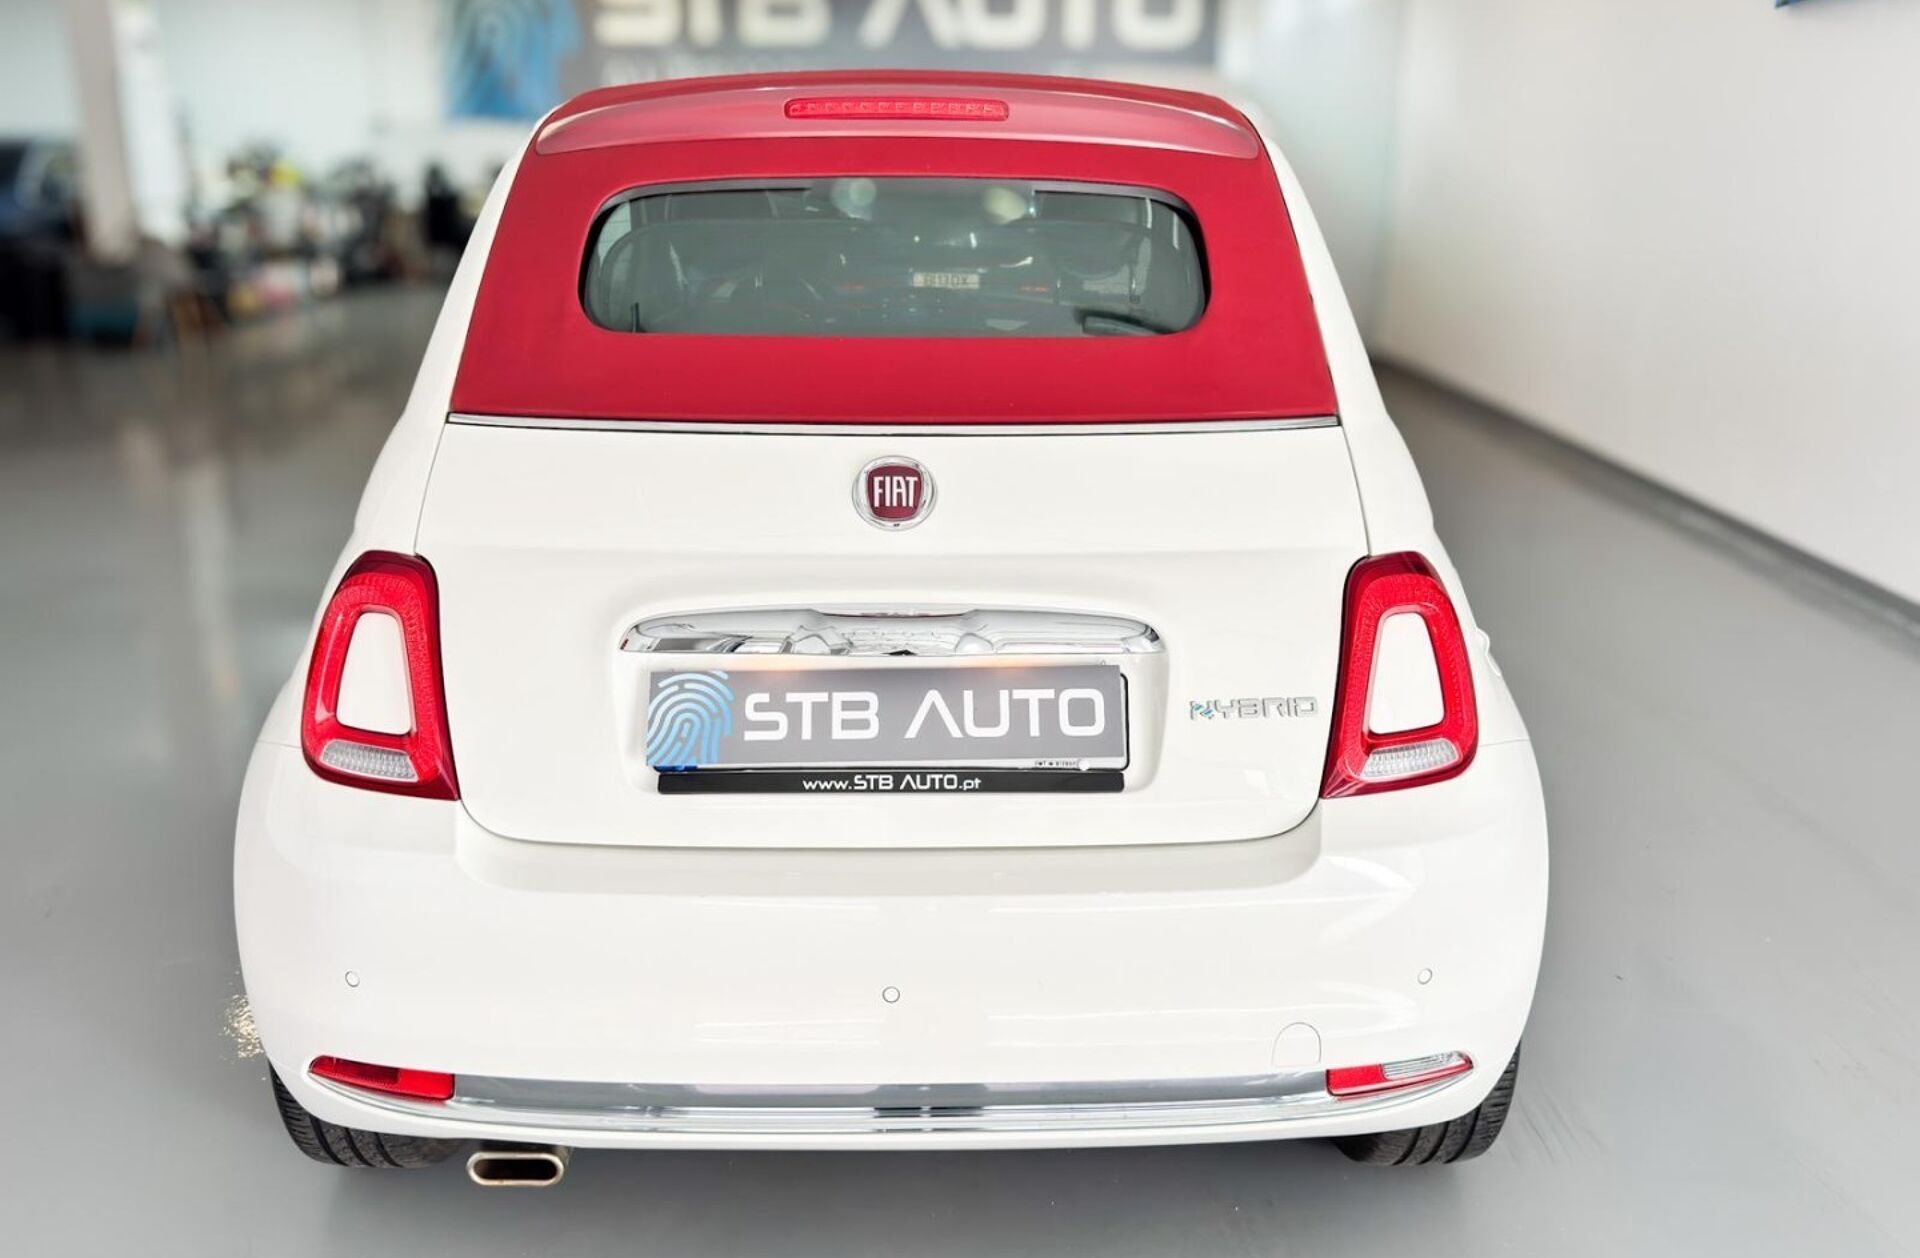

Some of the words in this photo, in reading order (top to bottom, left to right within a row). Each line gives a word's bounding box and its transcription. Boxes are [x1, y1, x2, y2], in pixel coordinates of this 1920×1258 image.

[873, 476, 919, 507] FIAT
[743, 691, 880, 741] STB
[904, 688, 1105, 738] AUTO
[1189, 697, 1318, 720] HYBRID
